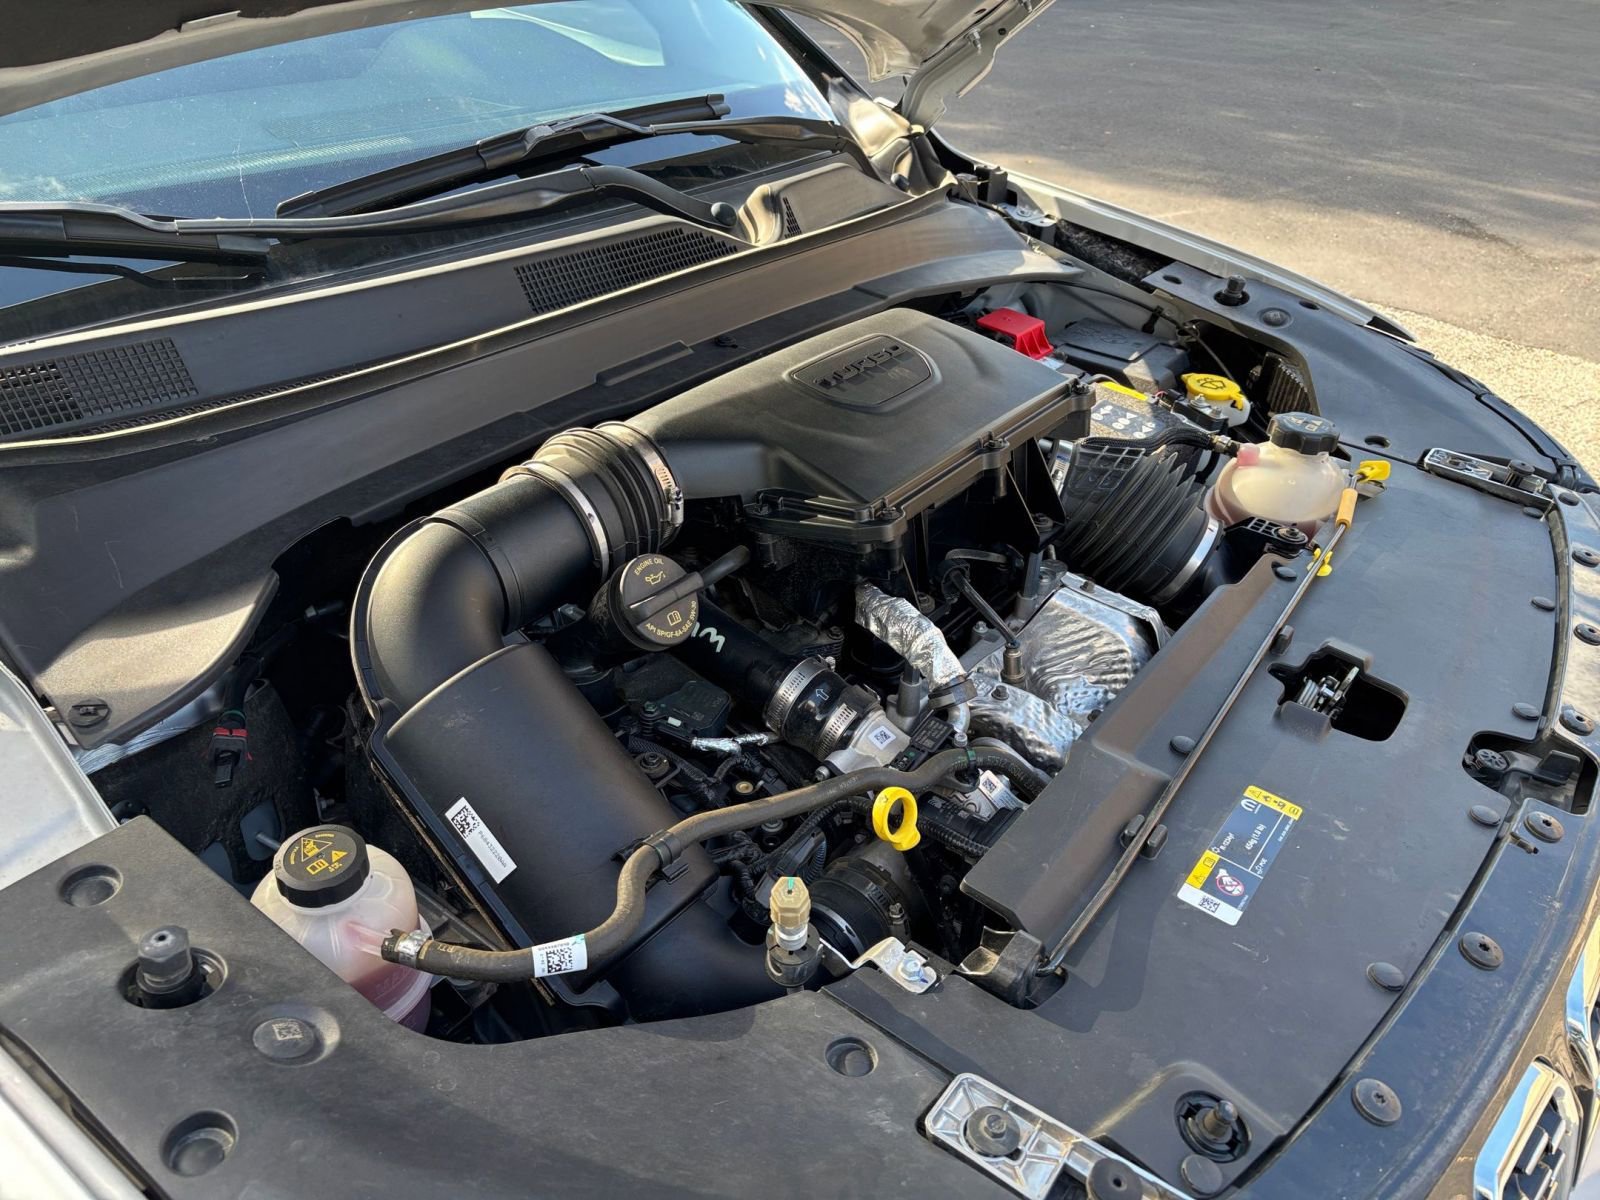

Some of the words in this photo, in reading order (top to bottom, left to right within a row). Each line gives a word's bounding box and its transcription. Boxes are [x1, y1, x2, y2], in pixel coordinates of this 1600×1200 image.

[634, 559, 653, 575] ENGINE
[653, 557, 664, 565] OIL
[645, 622, 656, 633] API
